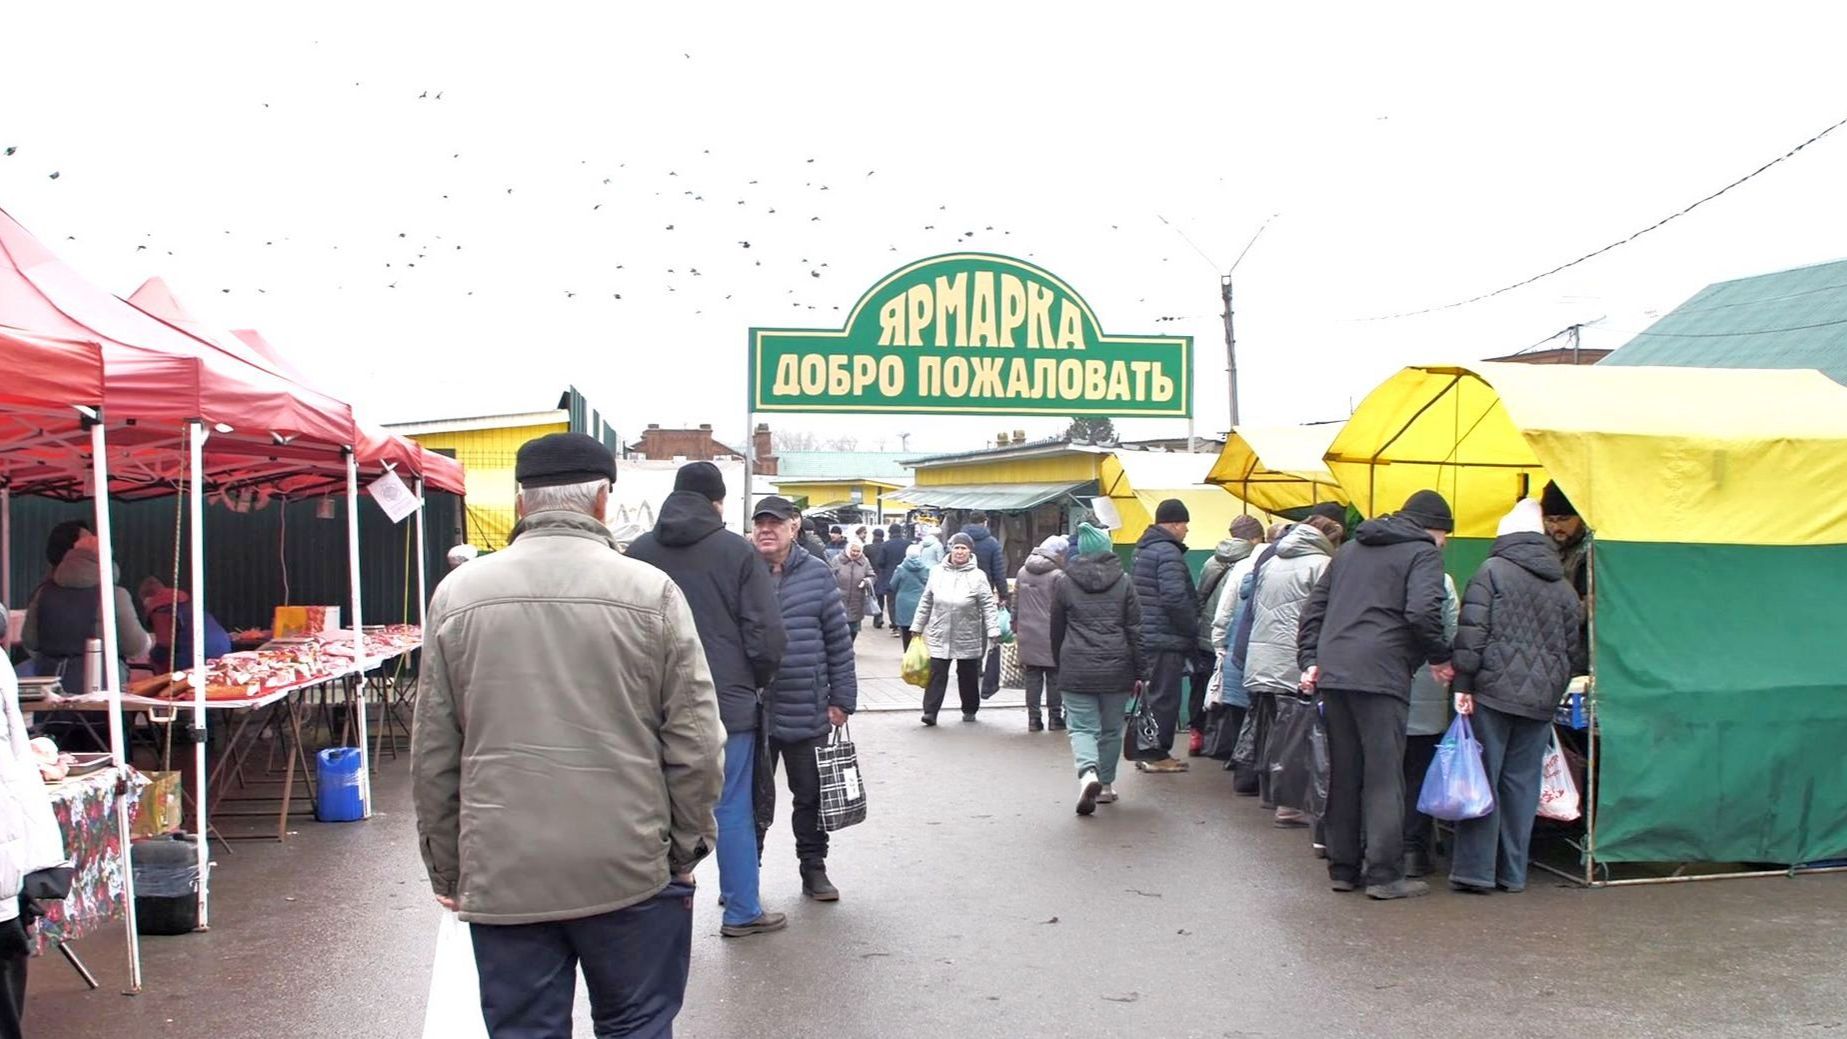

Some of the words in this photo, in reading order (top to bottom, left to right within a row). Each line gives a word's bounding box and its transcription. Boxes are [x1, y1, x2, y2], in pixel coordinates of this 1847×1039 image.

[878, 271, 1086, 350] ЯРМАРКА
[772, 354, 905, 397] ДОБРО
[918, 356, 1174, 402] ПОЖАЛОВАТЬ
